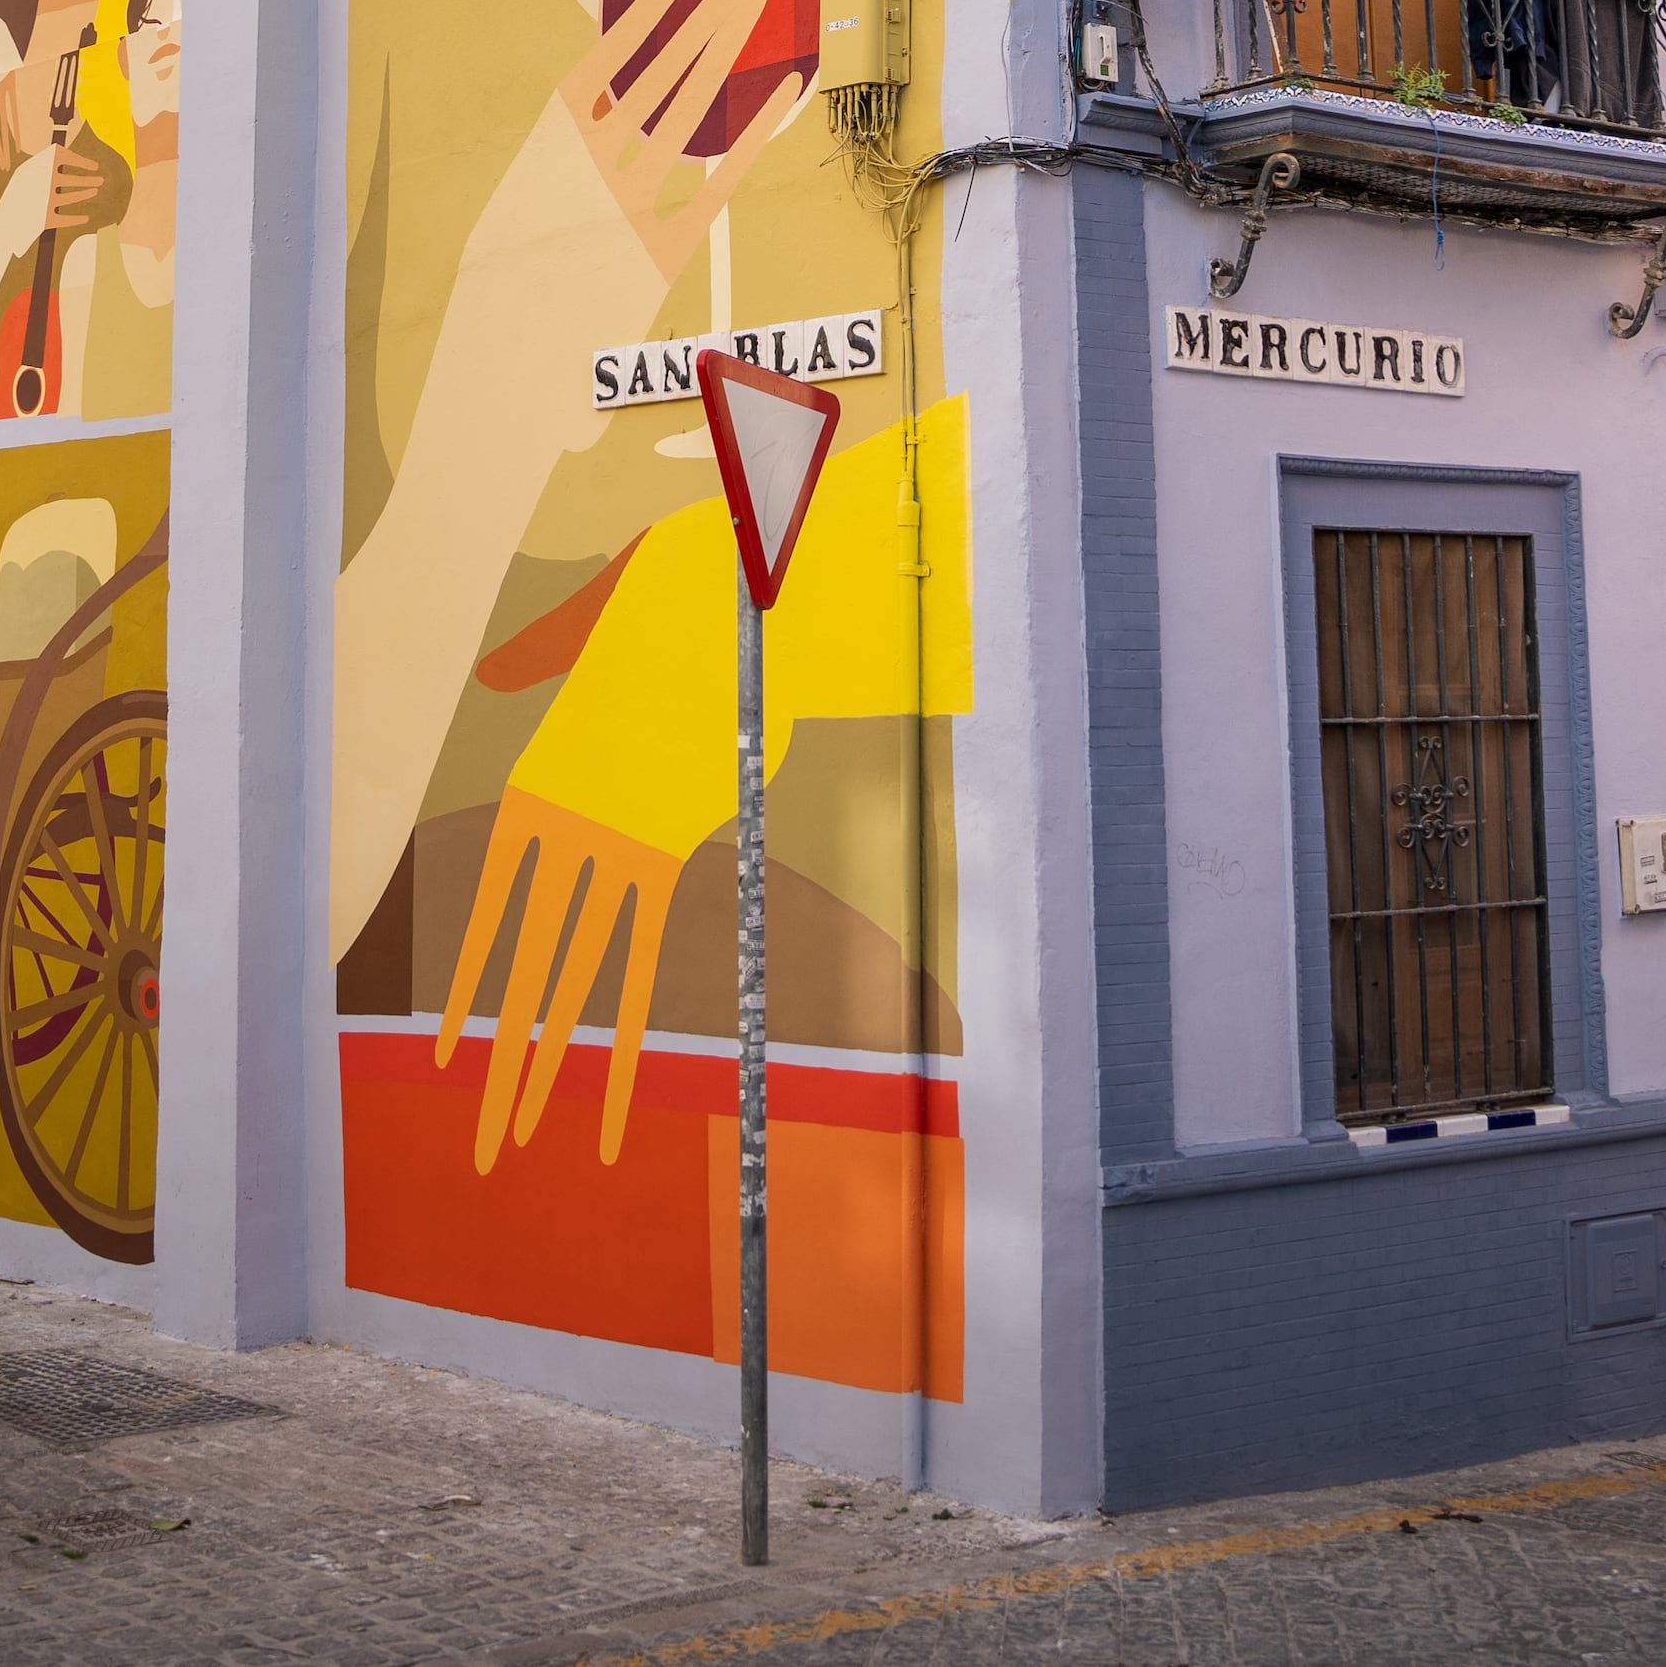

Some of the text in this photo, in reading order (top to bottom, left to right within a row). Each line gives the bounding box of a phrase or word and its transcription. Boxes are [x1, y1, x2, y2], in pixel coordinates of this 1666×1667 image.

[594, 318, 876, 402] SAN BLAS
[1174, 311, 1461, 388] MERCURIO
